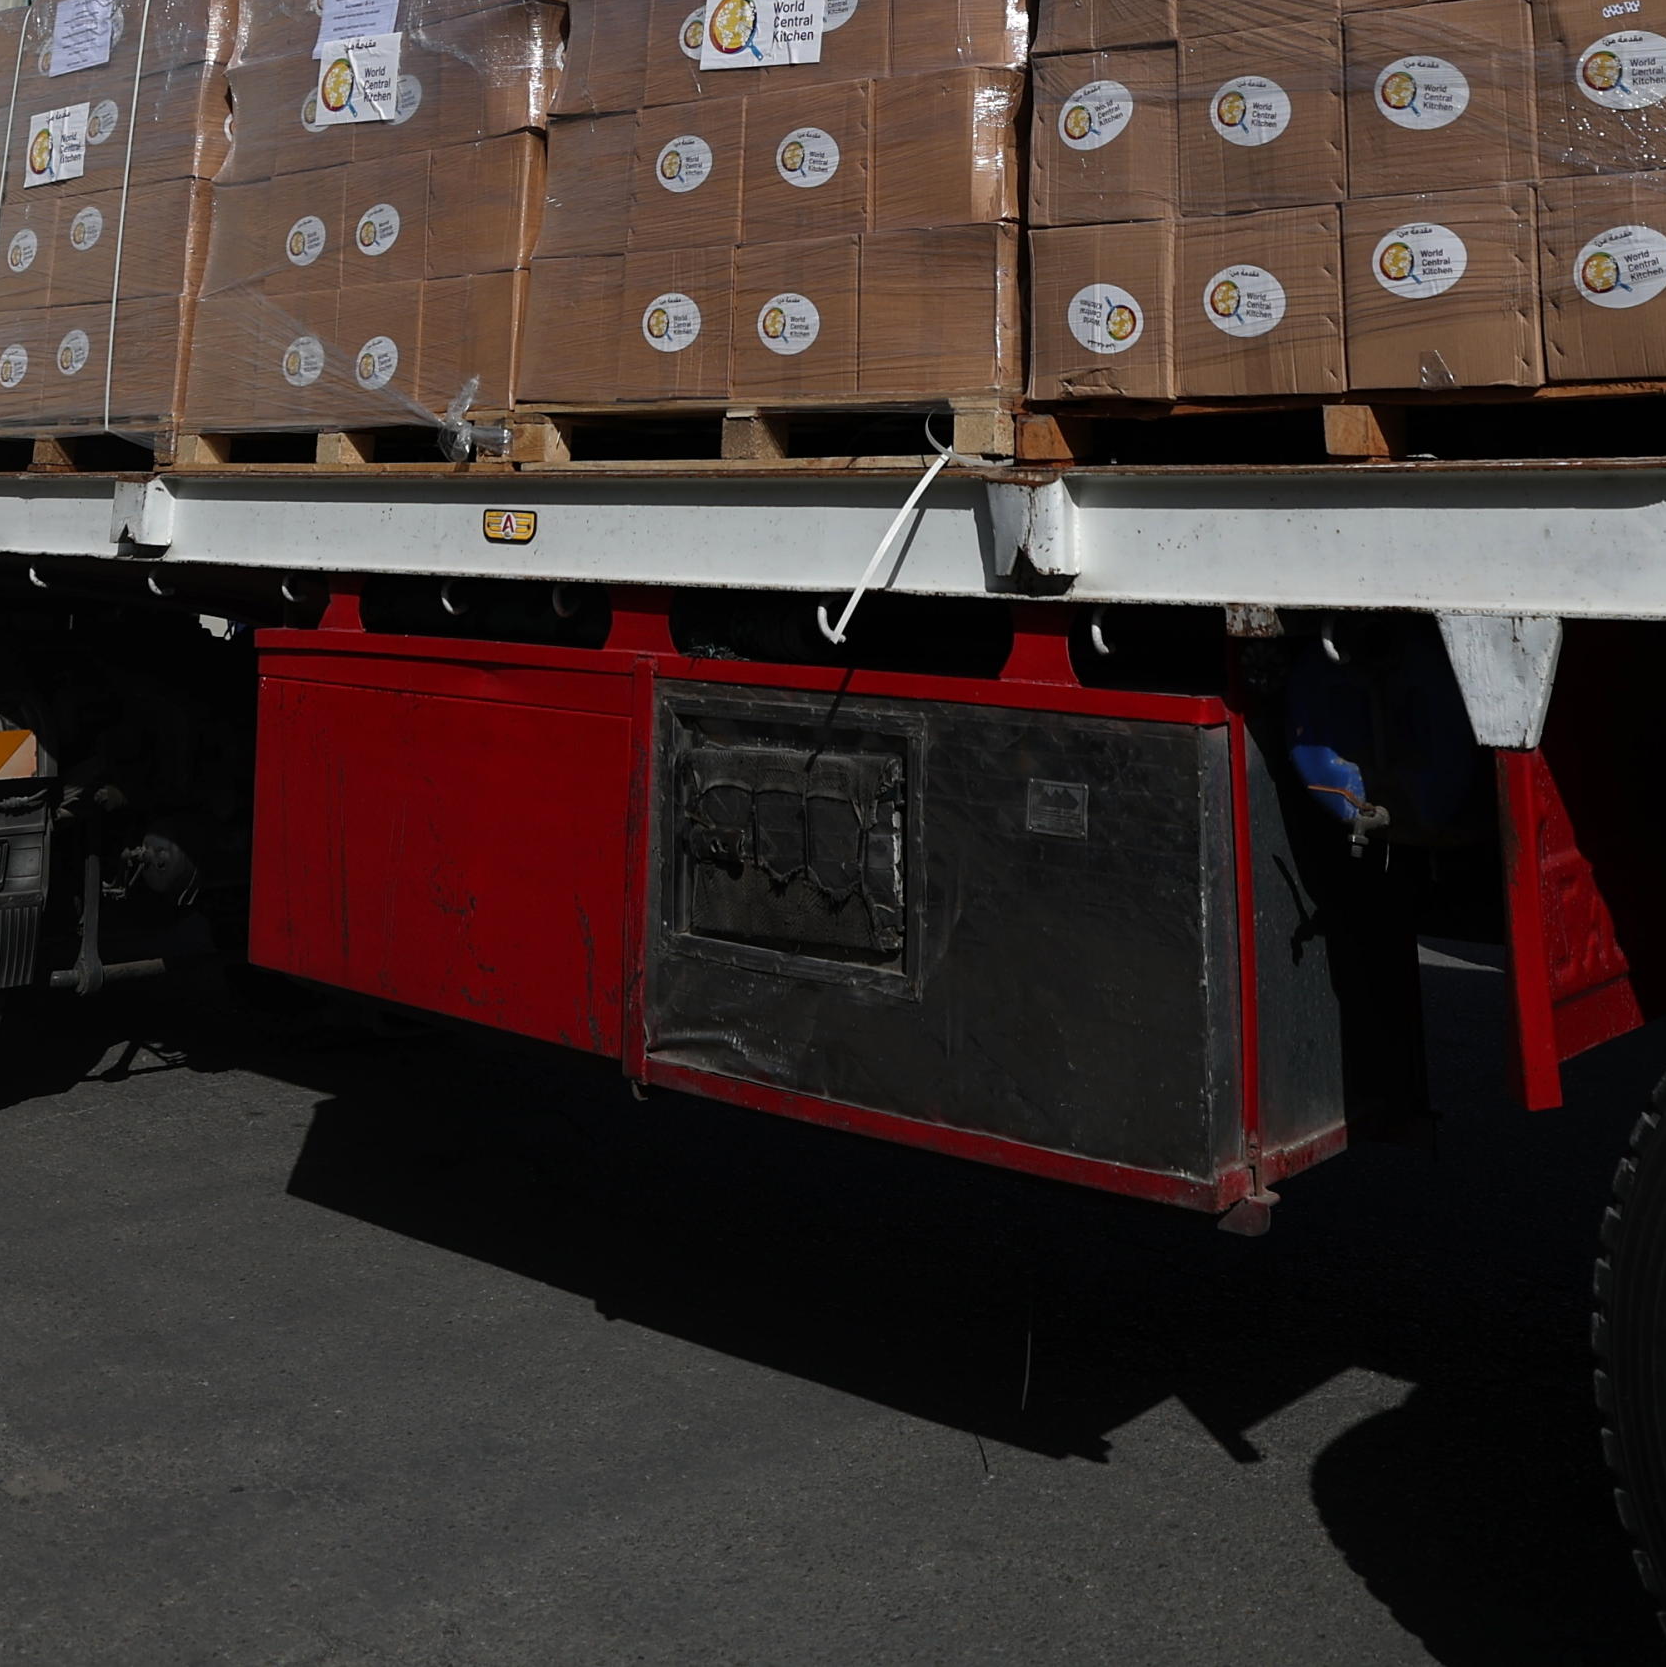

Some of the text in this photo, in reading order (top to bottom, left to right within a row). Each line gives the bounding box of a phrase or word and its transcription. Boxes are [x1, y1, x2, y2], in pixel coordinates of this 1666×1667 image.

[773, 0, 805, 14] World
[773, 14, 813, 28] Central
[773, 31, 814, 43] Kitchen
[1629, 57, 1656, 67] World
[364, 66, 386, 78] World
[1631, 66, 1664, 76] Central
[364, 78, 391, 90] Central
[1632, 76, 1666, 86] Kitchen
[364, 91, 391, 102] Kitchen
[1420, 249, 1444, 258] World
[1624, 250, 1650, 263] World
[1422, 259, 1451, 267] Central
[1627, 257, 1659, 272] Central
[1422, 266, 1453, 275] Kitchen
[1630, 266, 1664, 282] Kitchen
